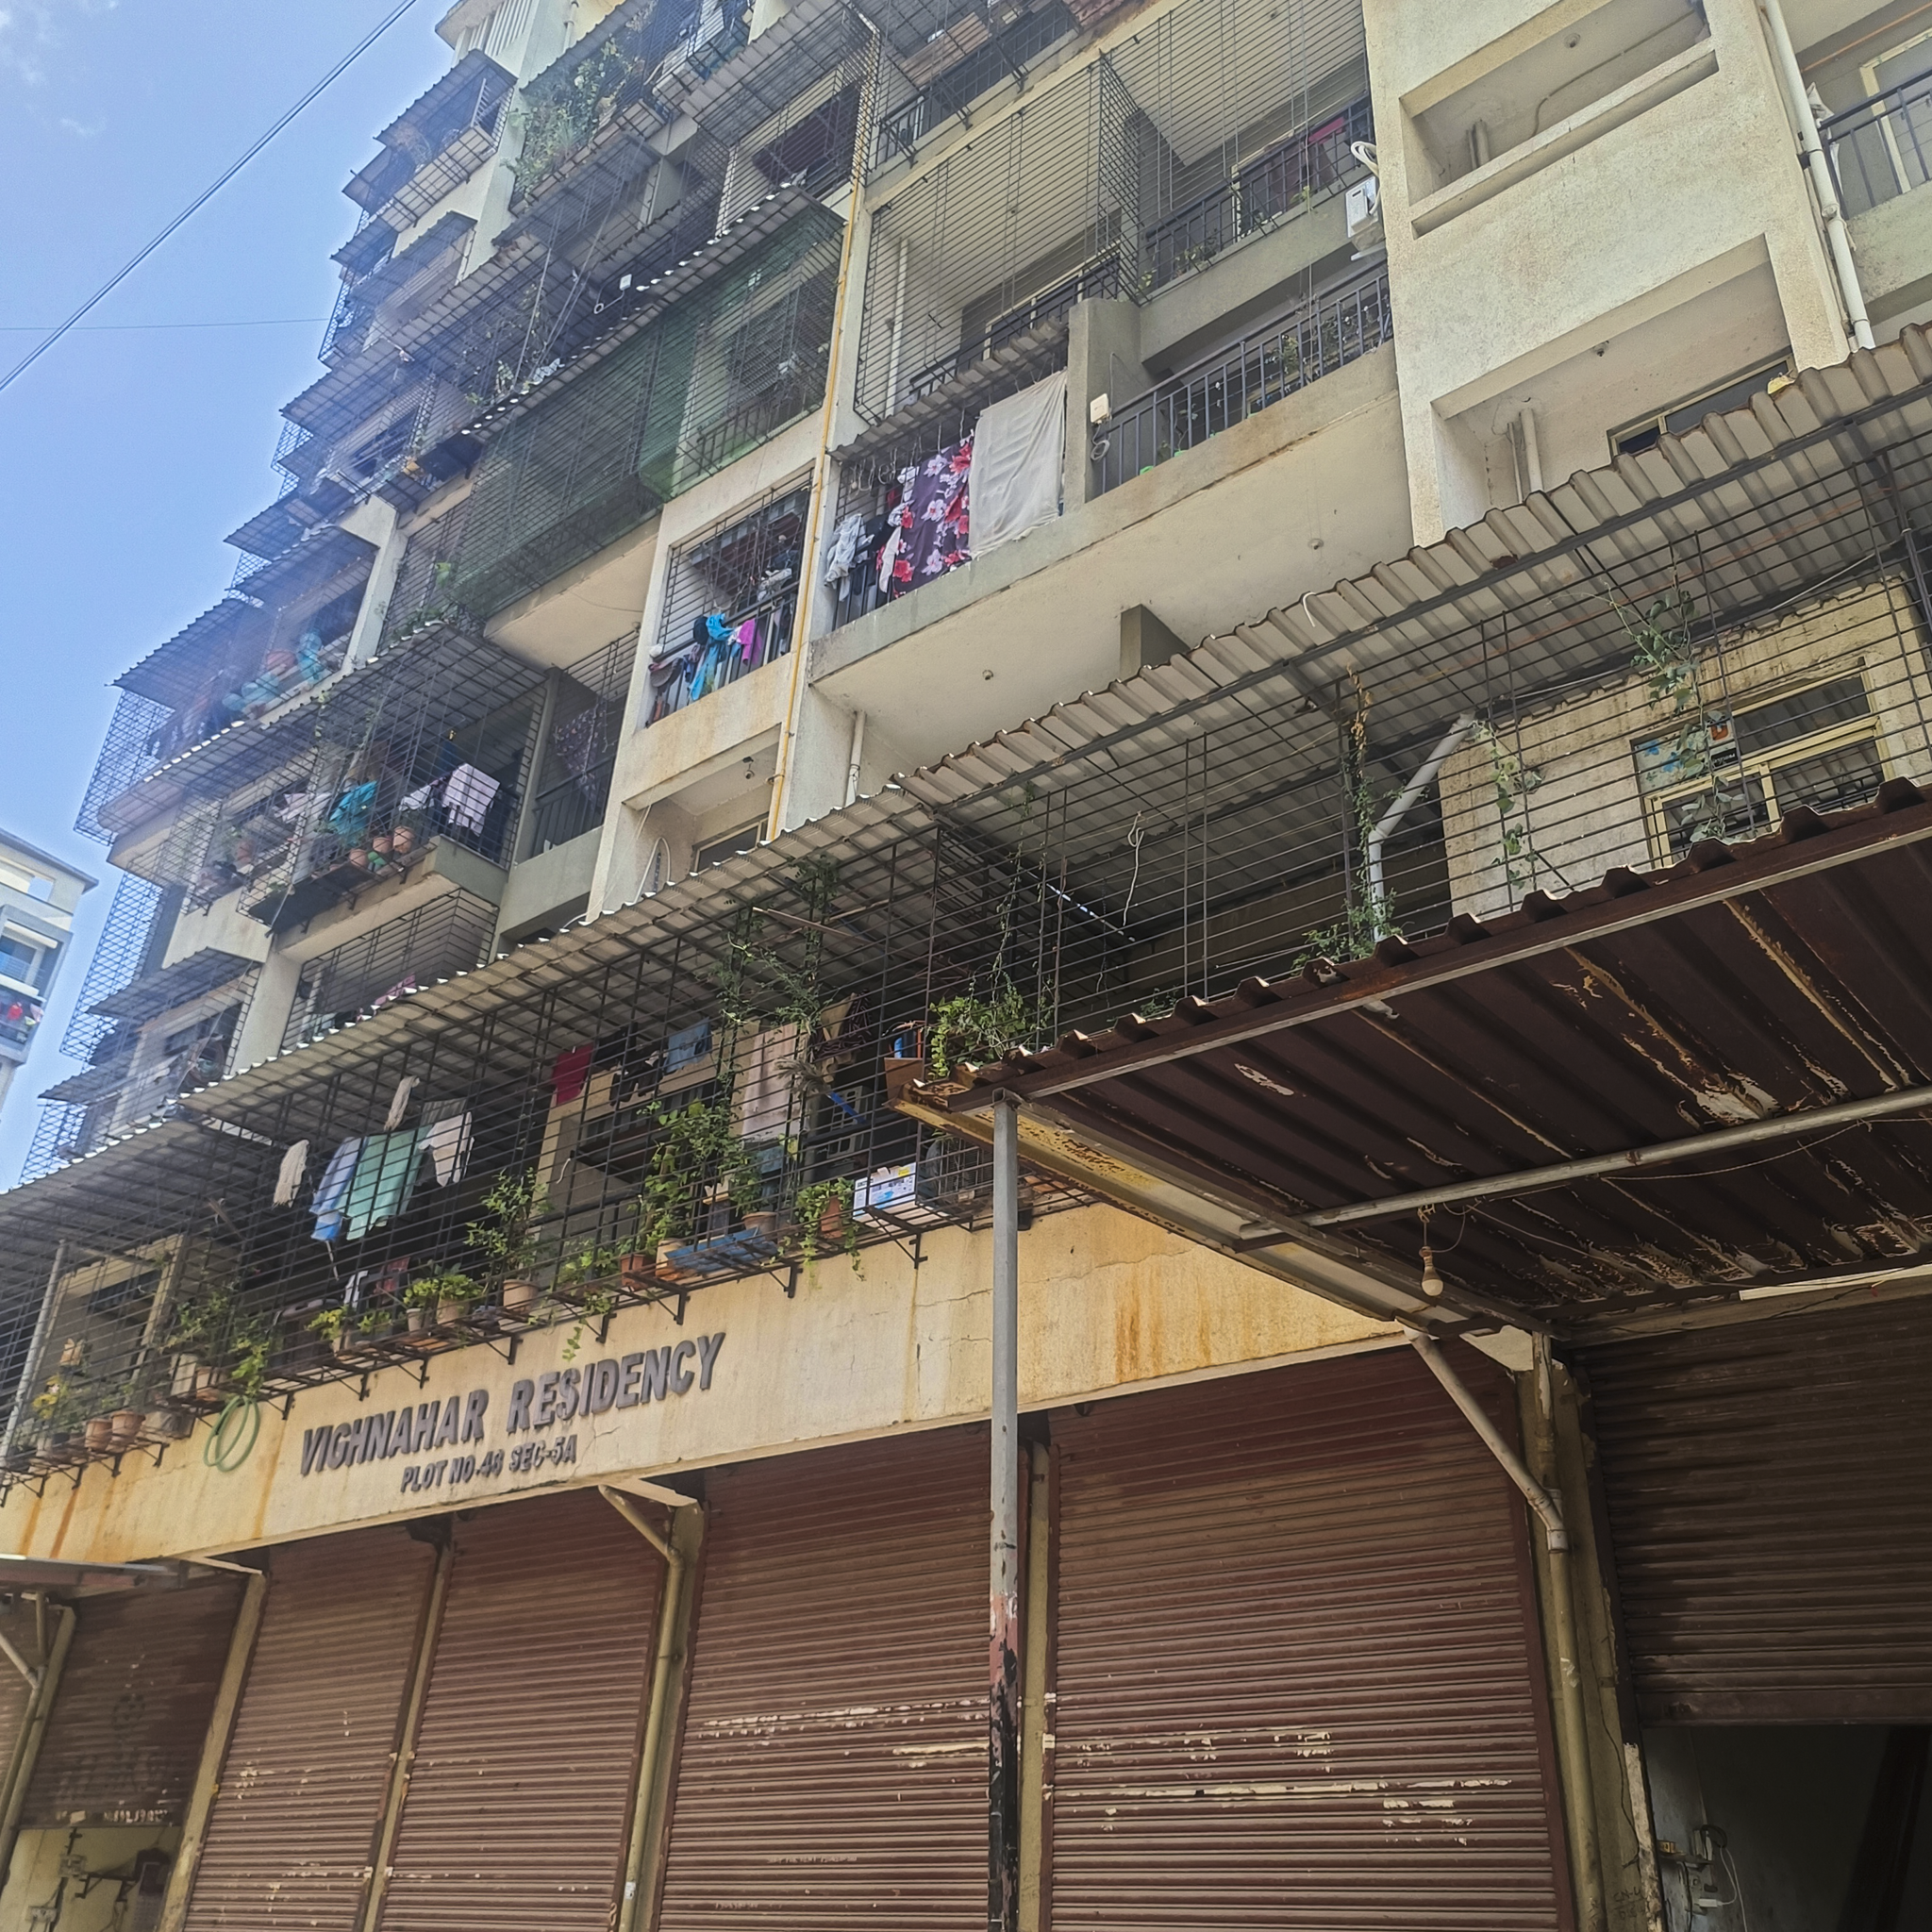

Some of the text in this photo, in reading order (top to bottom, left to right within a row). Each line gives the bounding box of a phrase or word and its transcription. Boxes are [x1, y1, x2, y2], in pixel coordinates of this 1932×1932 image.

[301, 1332, 726, 1477] VIGHNAHAR RESIDENCY
[401, 1459, 448, 1492] PLOT
